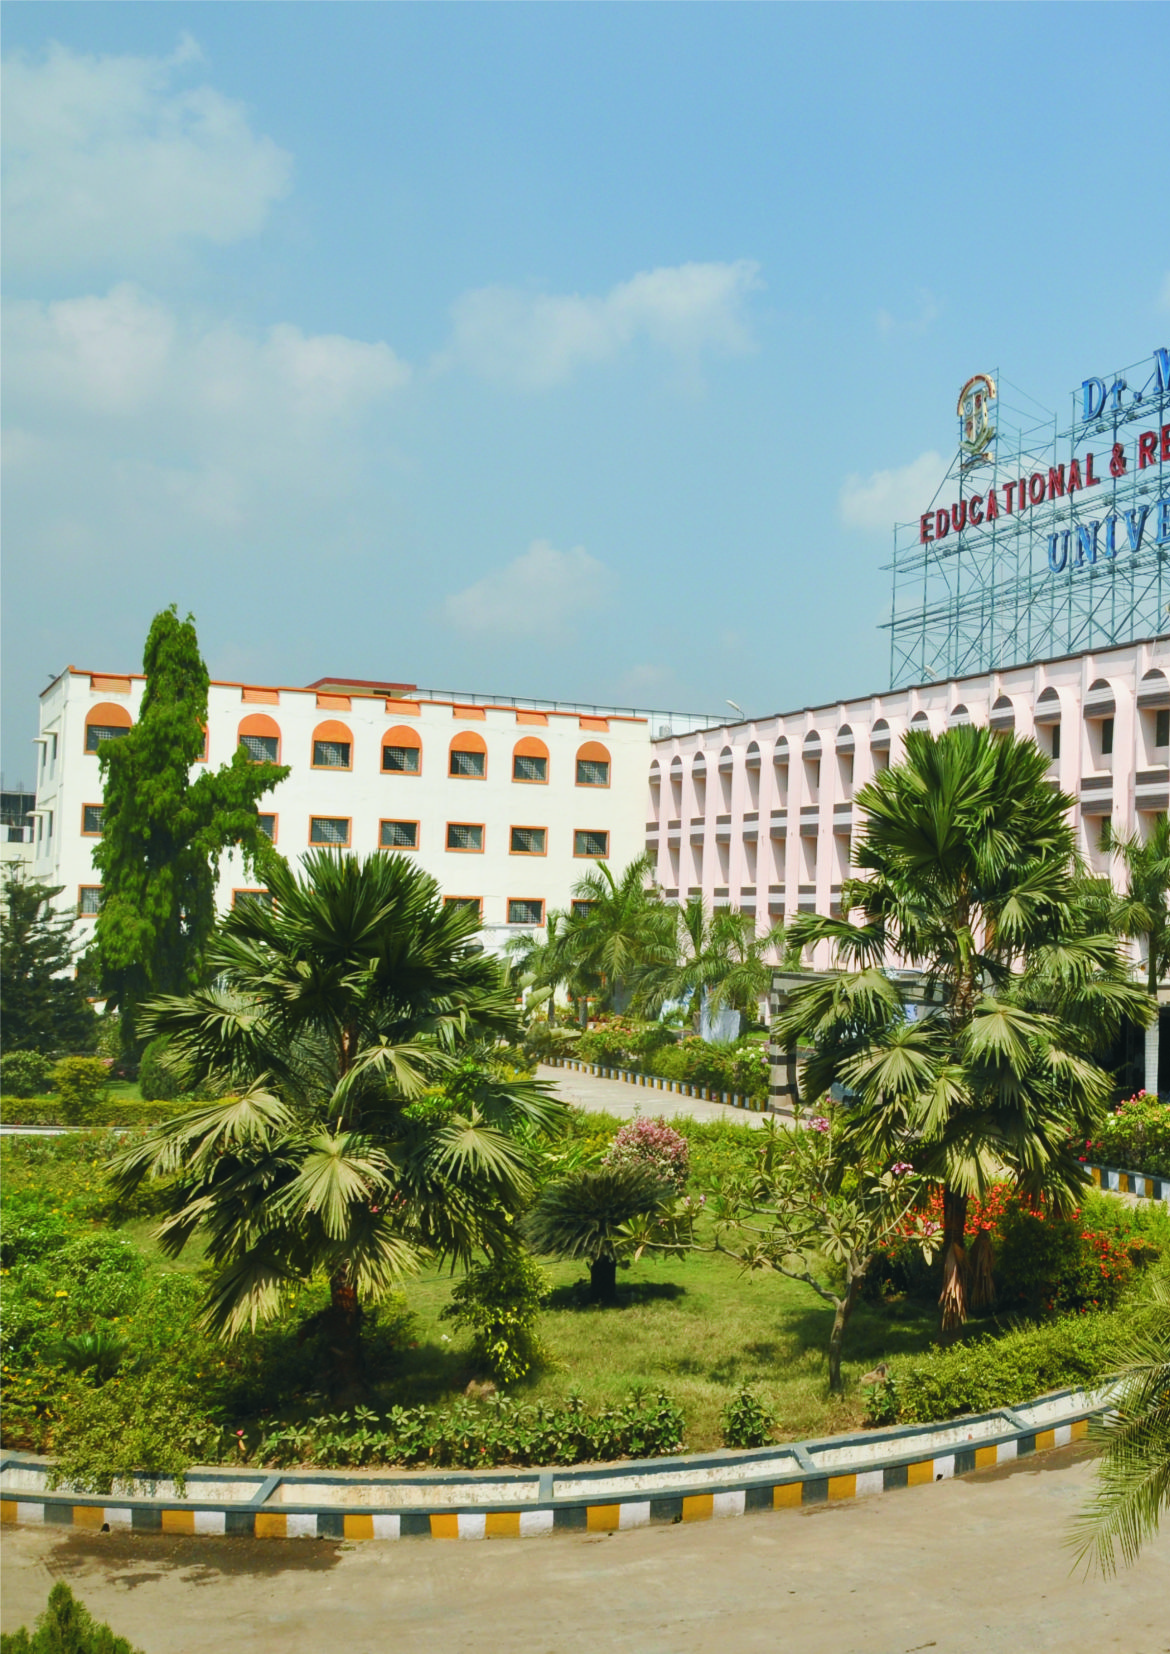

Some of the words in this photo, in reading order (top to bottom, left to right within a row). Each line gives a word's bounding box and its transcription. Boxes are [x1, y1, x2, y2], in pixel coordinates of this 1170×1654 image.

[1082, 377, 1142, 422] Dr.
[920, 453, 1100, 544] EDUCATIONAL
[1109, 442, 1127, 477] &
